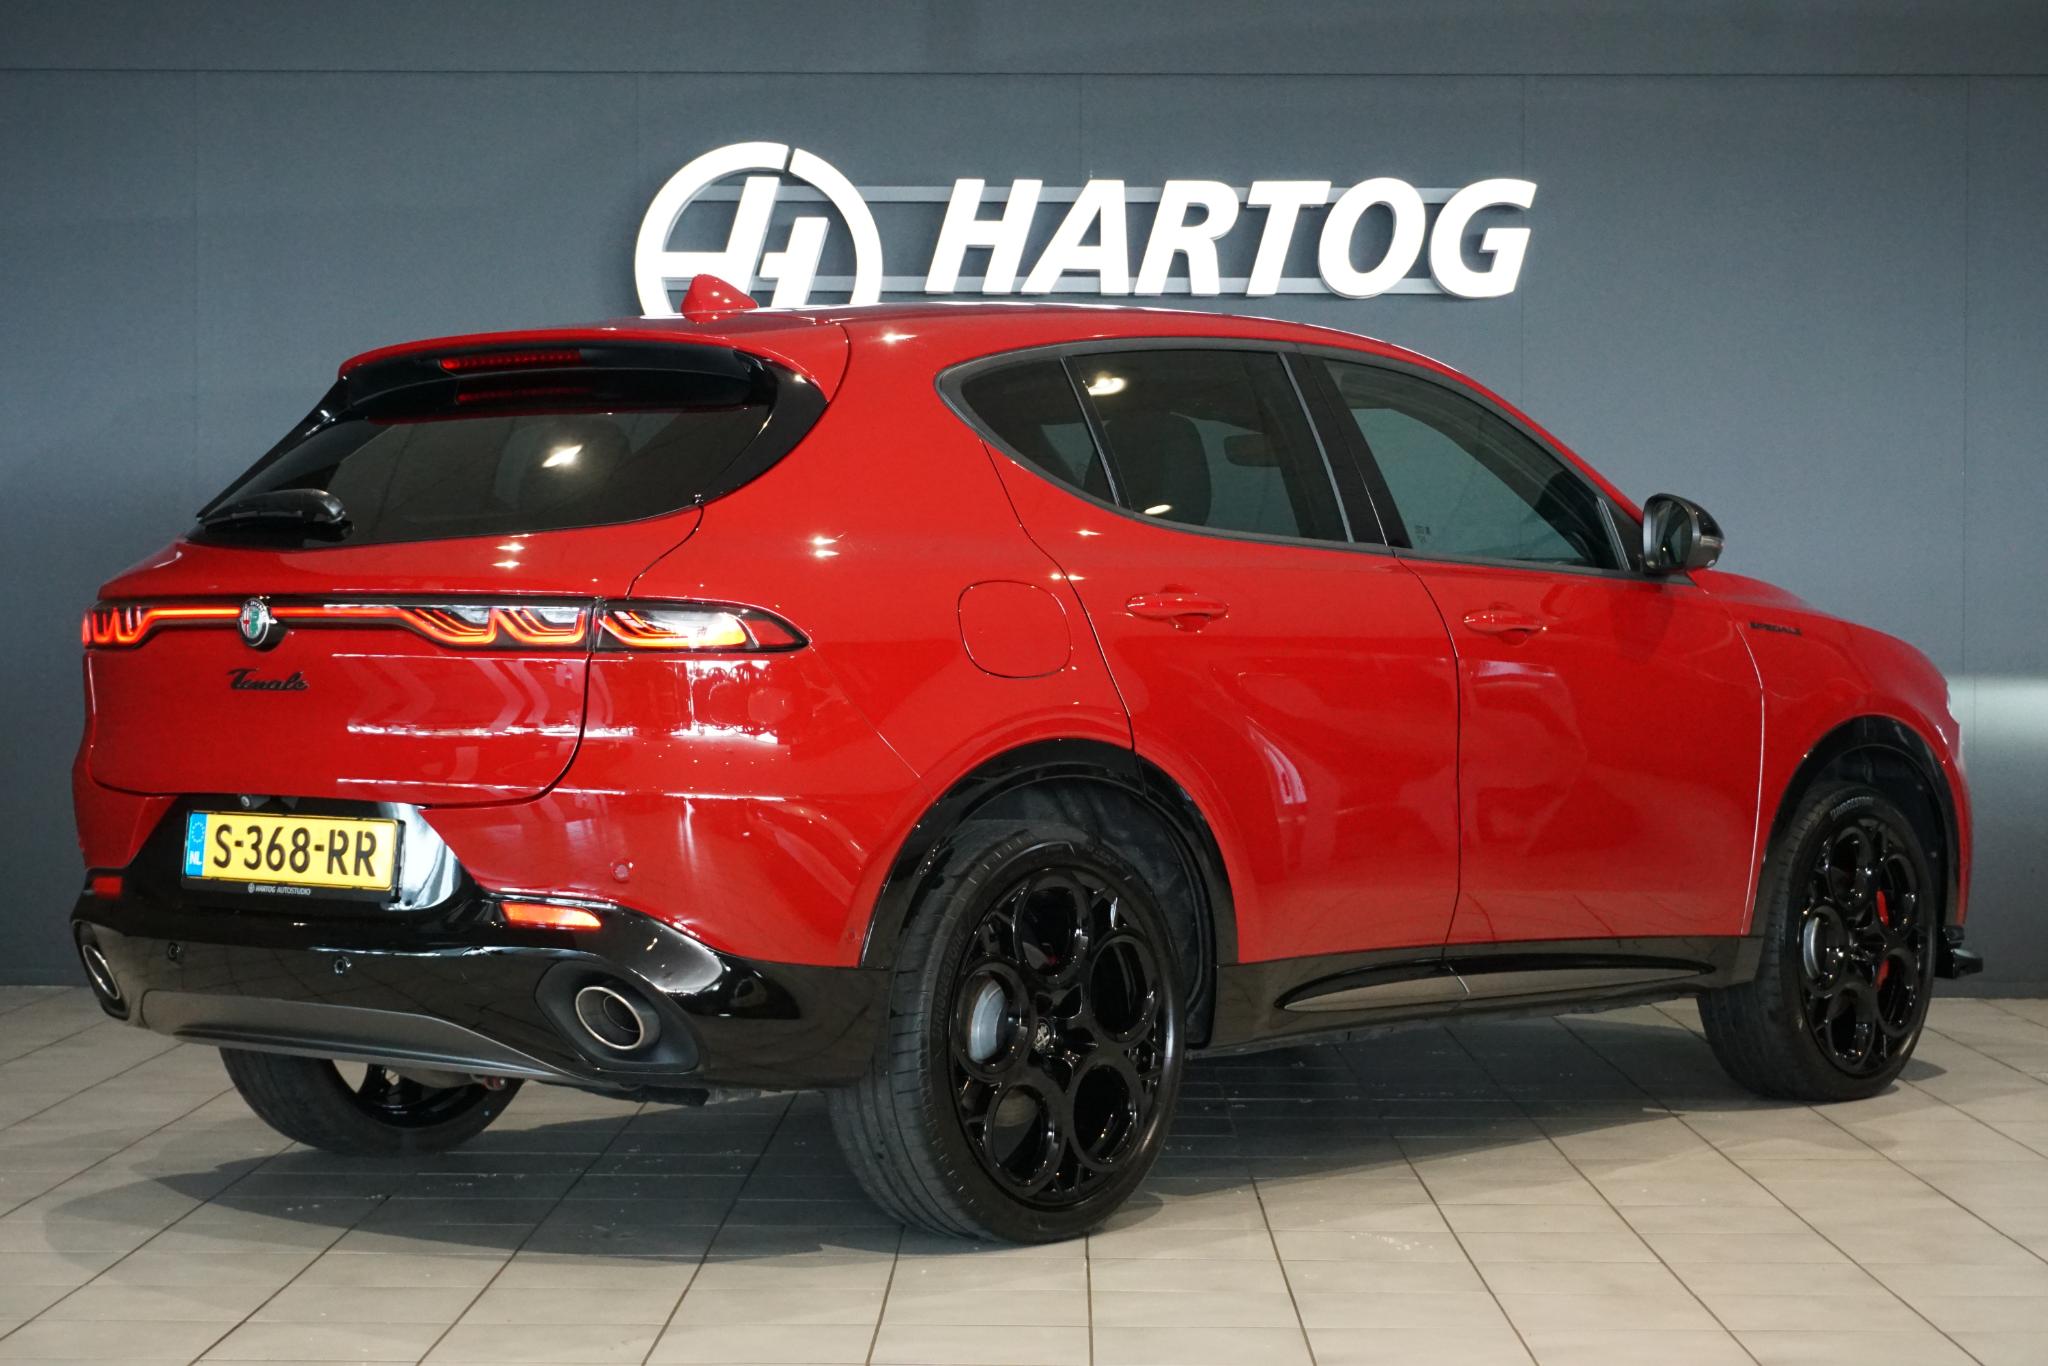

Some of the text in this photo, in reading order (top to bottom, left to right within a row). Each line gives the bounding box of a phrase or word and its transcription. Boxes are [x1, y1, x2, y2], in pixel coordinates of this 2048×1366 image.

[925, 177, 1537, 299] HARTOG
[189, 850, 203, 865] NL
[213, 823, 377, 877] S-368-RR
[277, 886, 311, 896] AUTOSTUDIO
